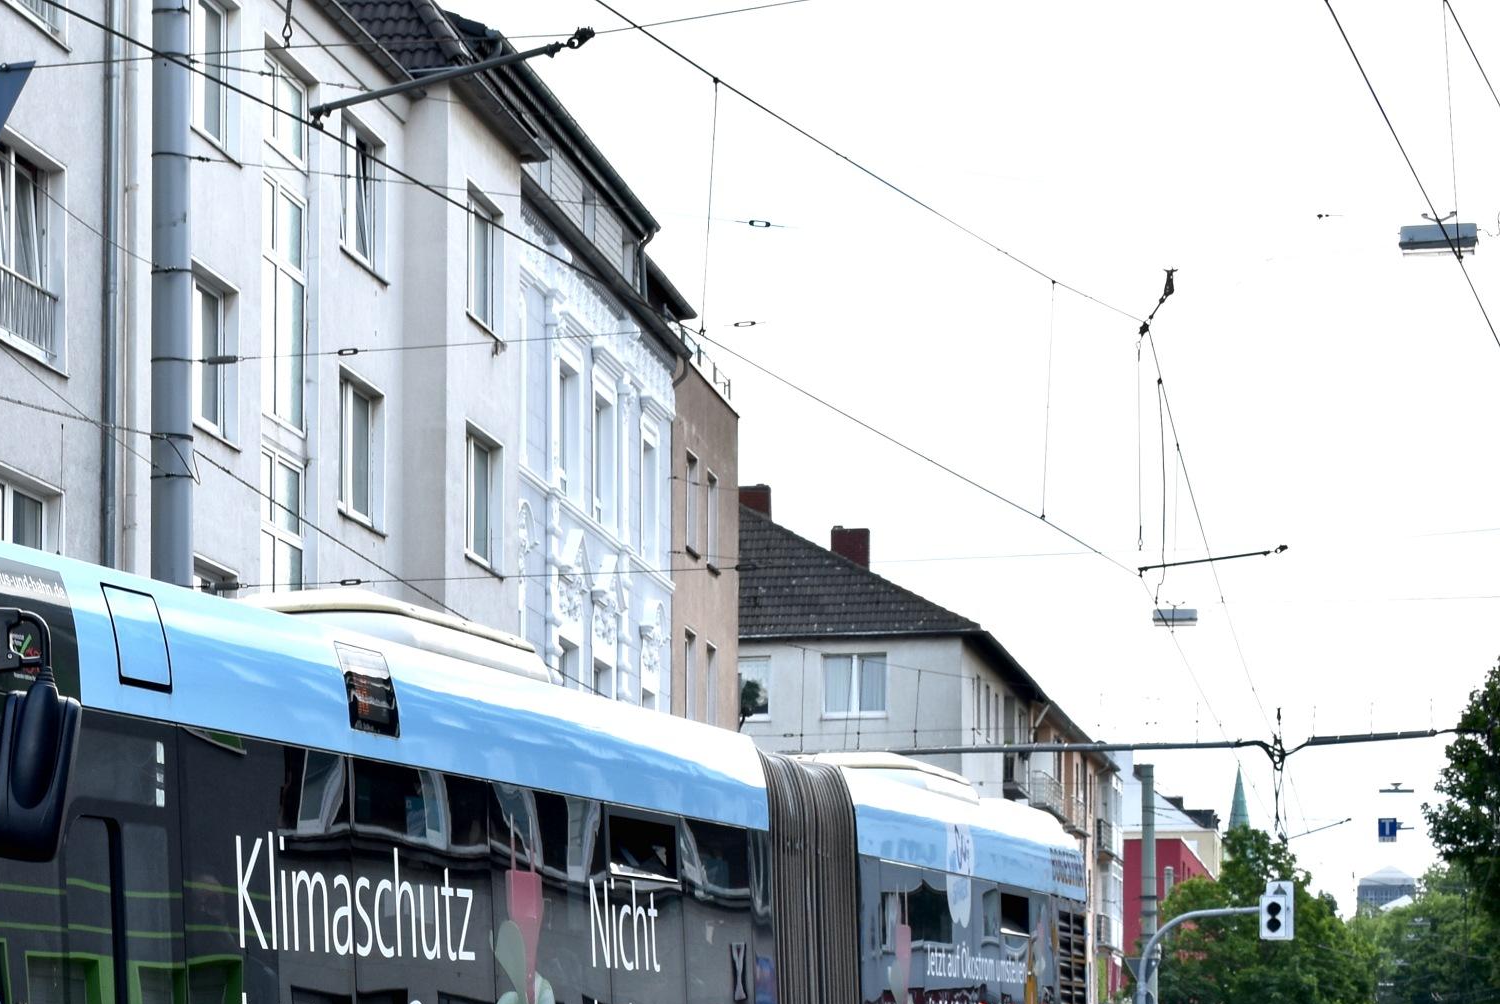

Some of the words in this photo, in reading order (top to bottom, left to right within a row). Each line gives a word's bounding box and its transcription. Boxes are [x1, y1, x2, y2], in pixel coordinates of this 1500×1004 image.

[235, 831, 476, 962] Klimaschutz
[589, 878, 661, 973] Nicht
[927, 943, 946, 977] Jetzt
[947, 944, 960, 979] auf
[961, 941, 995, 981] Ökostrom
